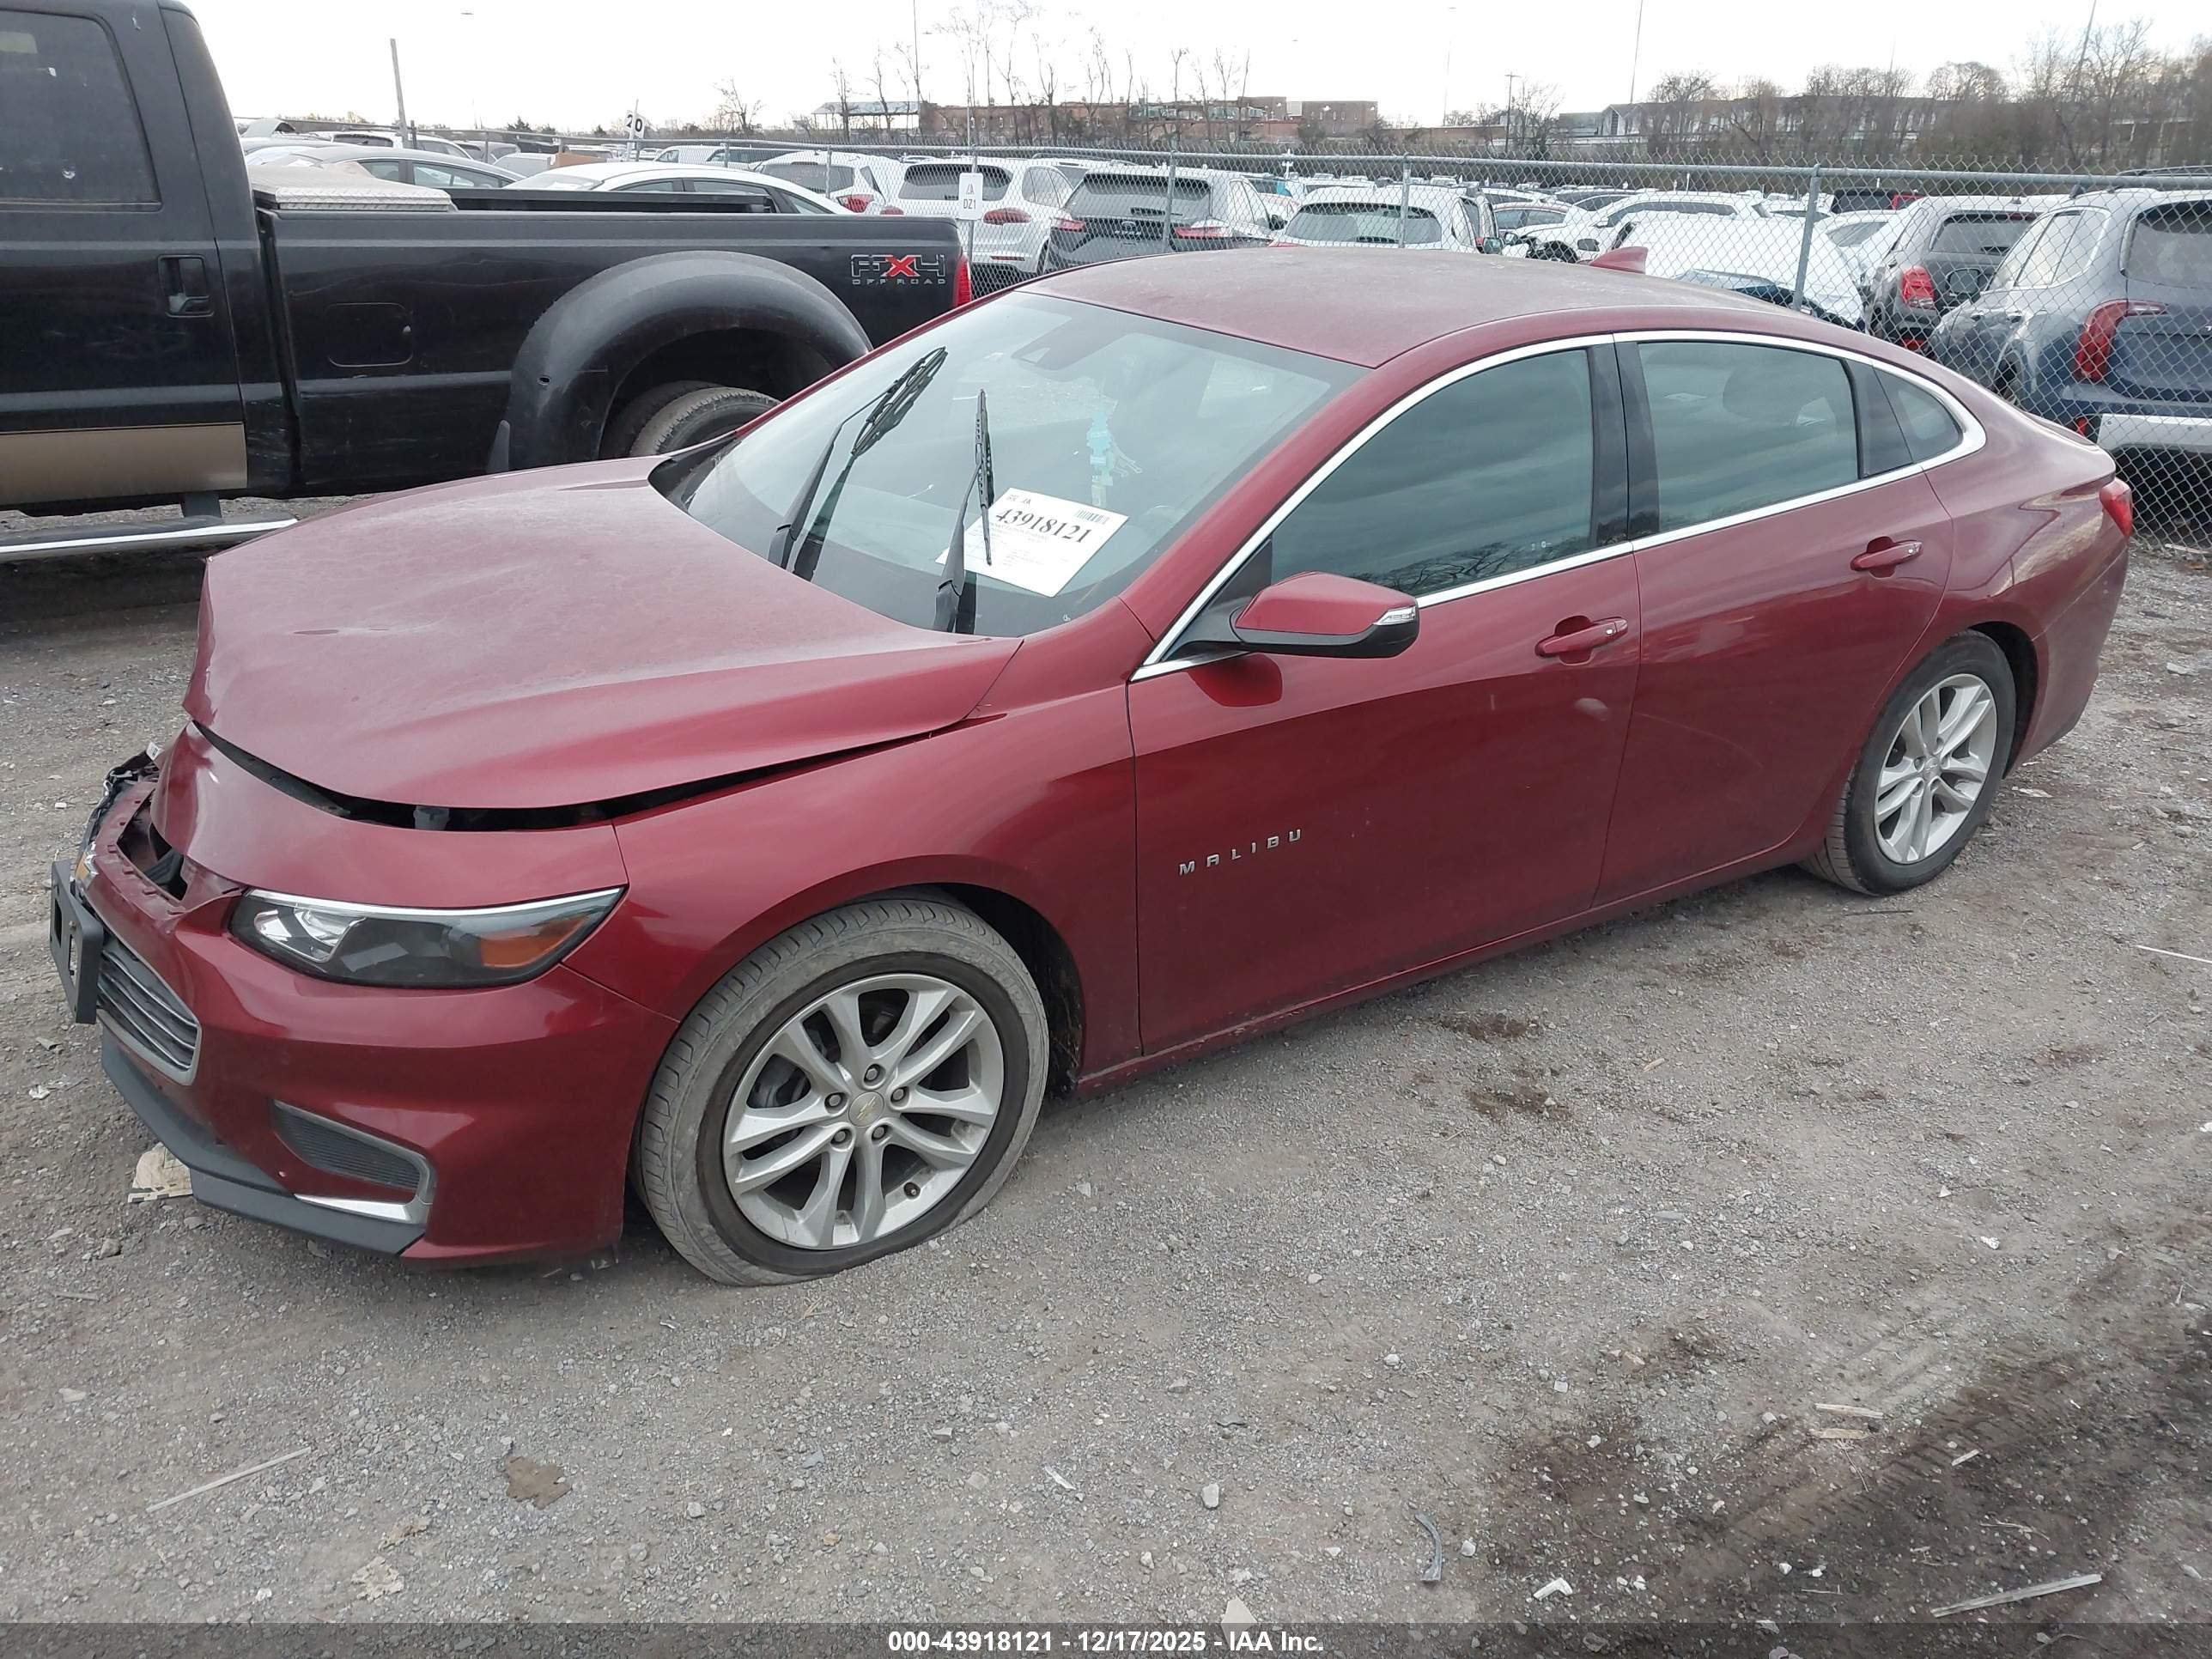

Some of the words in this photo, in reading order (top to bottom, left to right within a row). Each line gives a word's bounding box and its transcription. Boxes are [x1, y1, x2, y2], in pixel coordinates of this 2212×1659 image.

[850, 253, 946, 277] FX4
[995, 508, 1093, 544] 43918121
[1178, 829, 1302, 876] MALIBU
